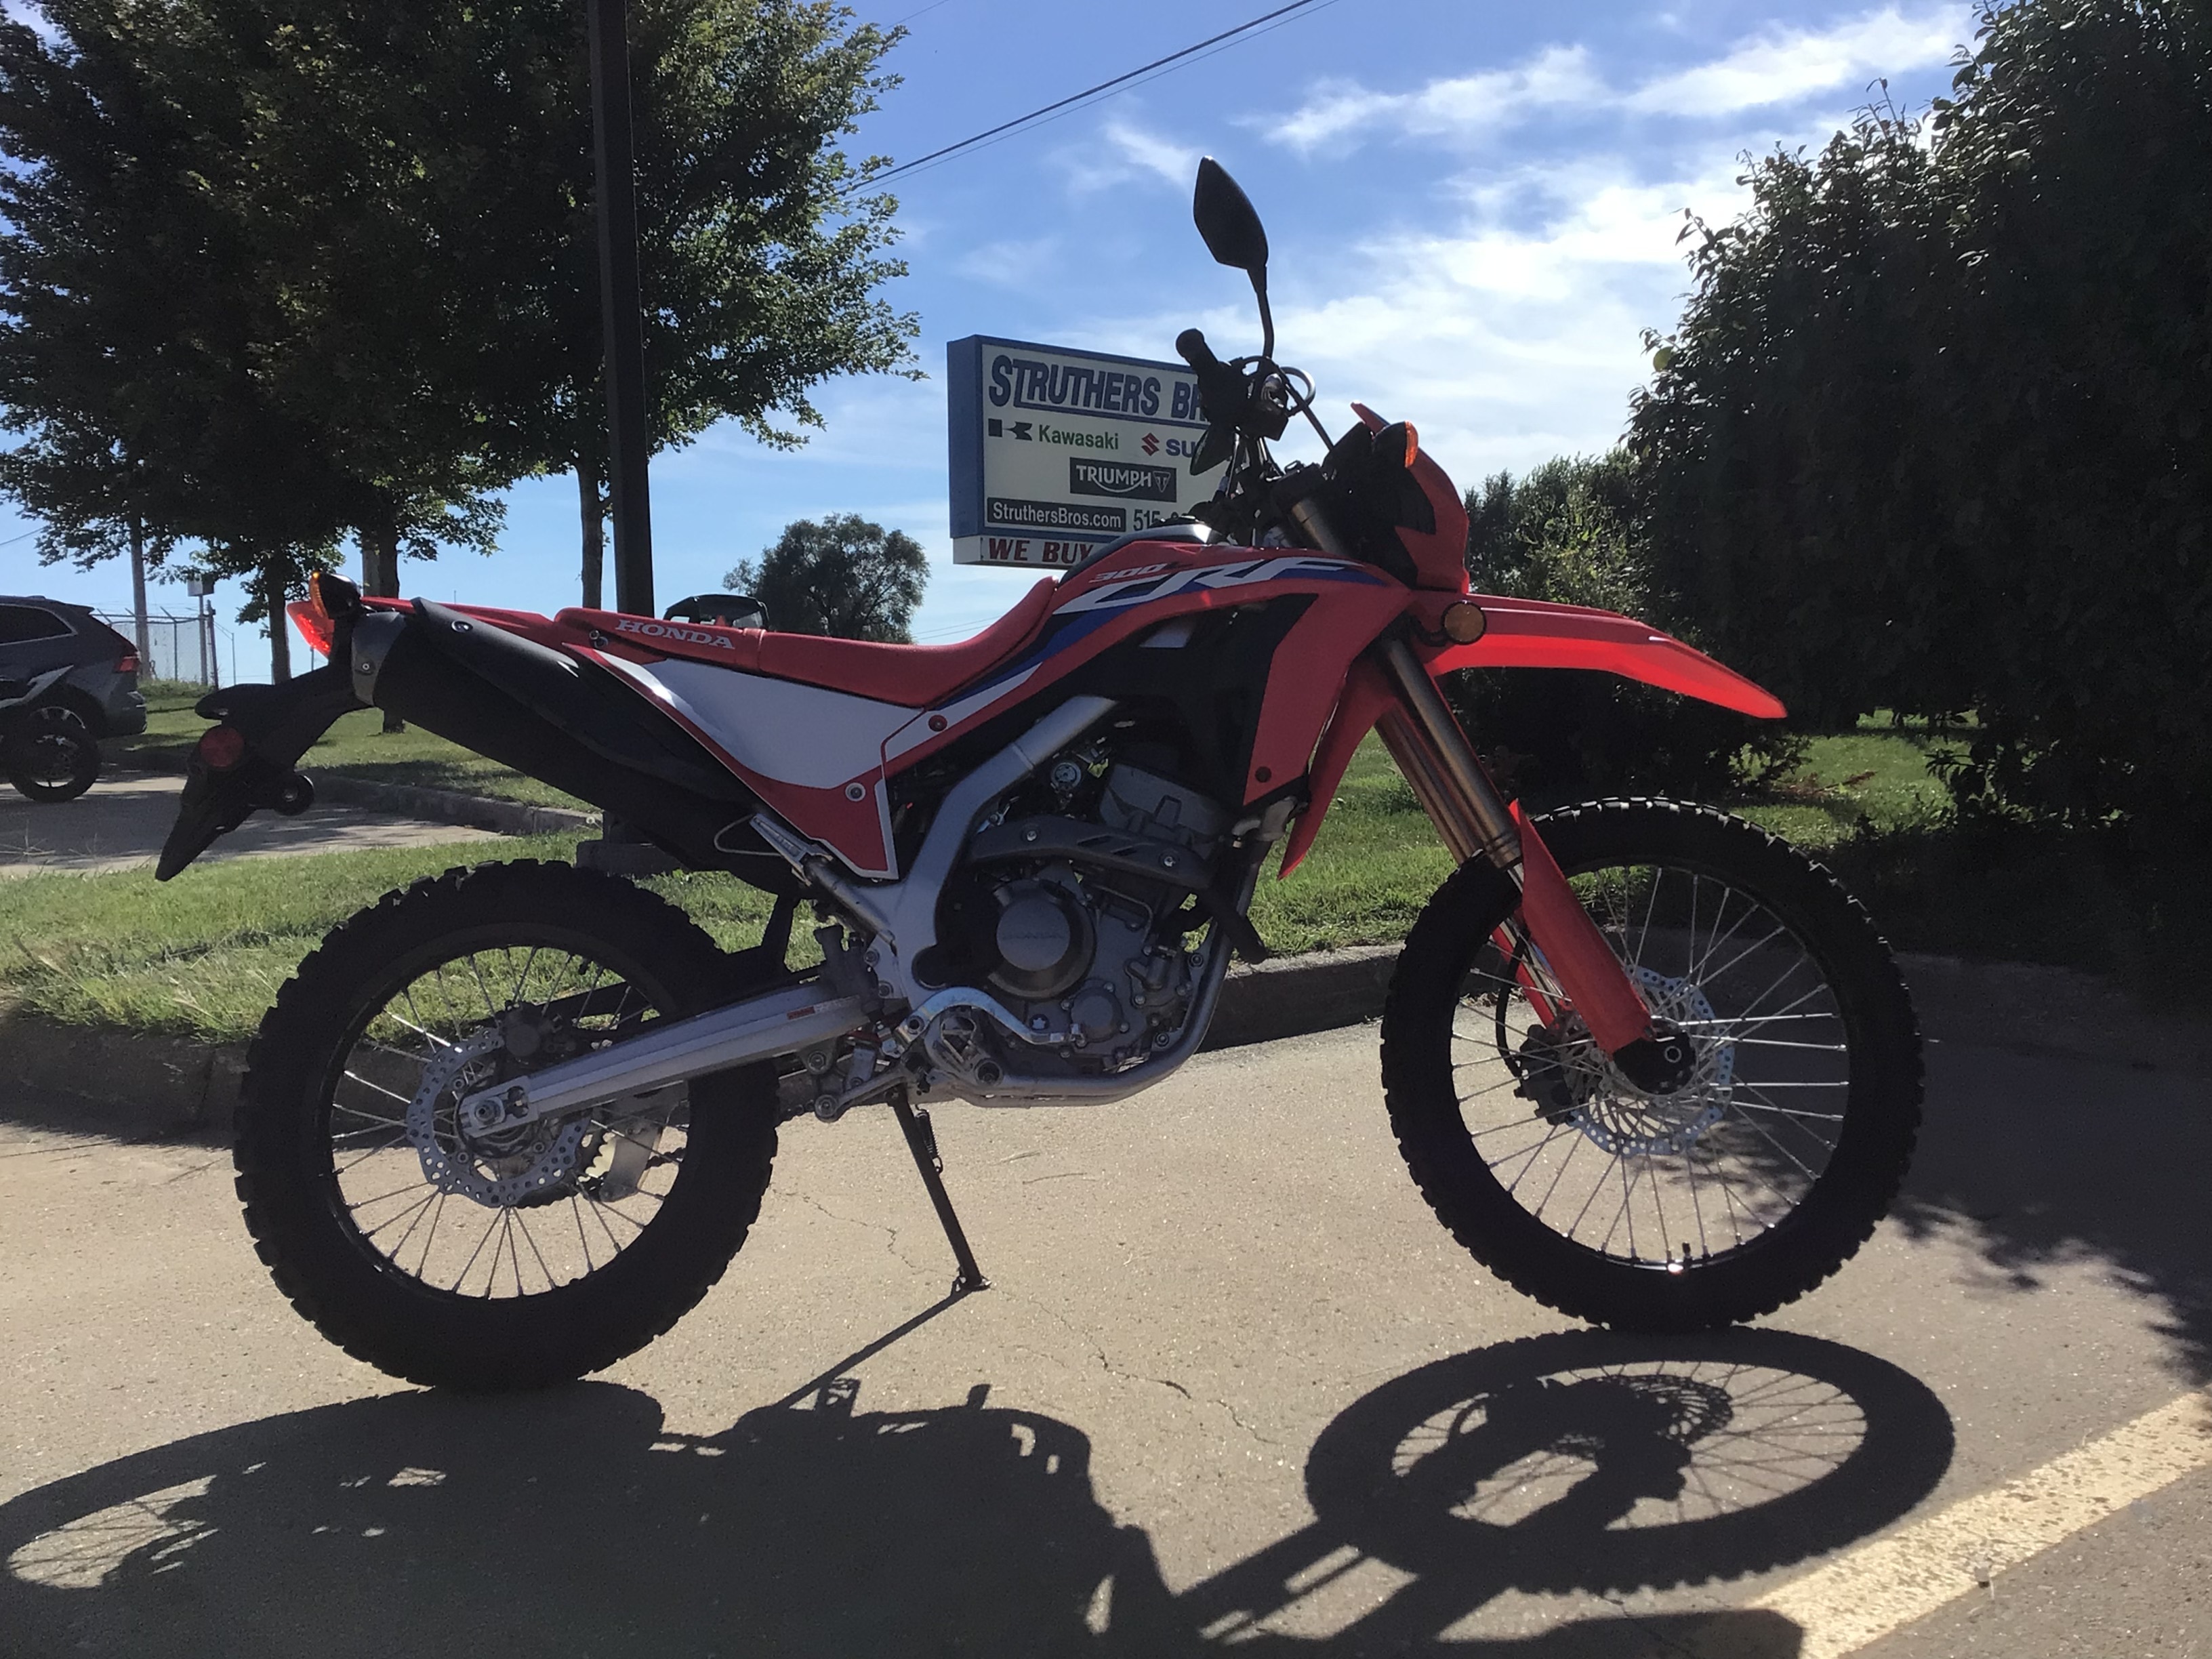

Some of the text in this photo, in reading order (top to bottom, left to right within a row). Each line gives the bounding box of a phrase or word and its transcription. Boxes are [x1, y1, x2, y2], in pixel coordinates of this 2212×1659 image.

[989, 354, 1161, 416] STRUTHERS
[1039, 424, 1119, 450] Kawasaki
[1076, 465, 1151, 493] TRIUMPH
[993, 501, 1121, 528] StruthersBros.com
[989, 538, 1093, 564] WE BUY
[615, 619, 735, 650] HONDA
